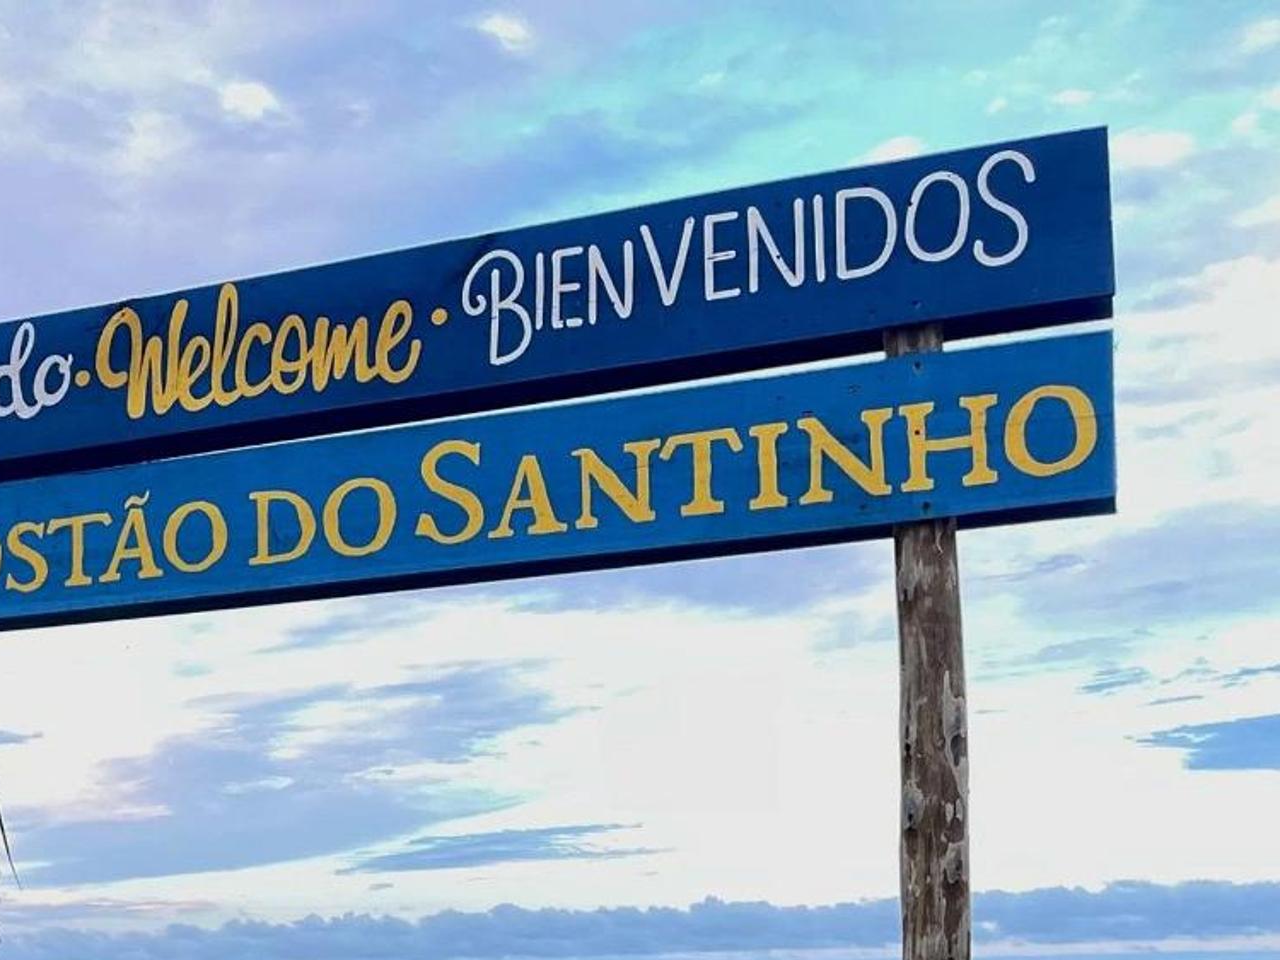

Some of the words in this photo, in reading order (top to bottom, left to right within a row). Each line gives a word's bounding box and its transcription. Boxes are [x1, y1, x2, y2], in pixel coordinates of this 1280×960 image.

[96, 283, 420, 419] Welcome
[462, 150, 1036, 366] BIENVENIDOS
[248, 477, 397, 566] DO
[415, 385, 1098, 545] SANTINHO
